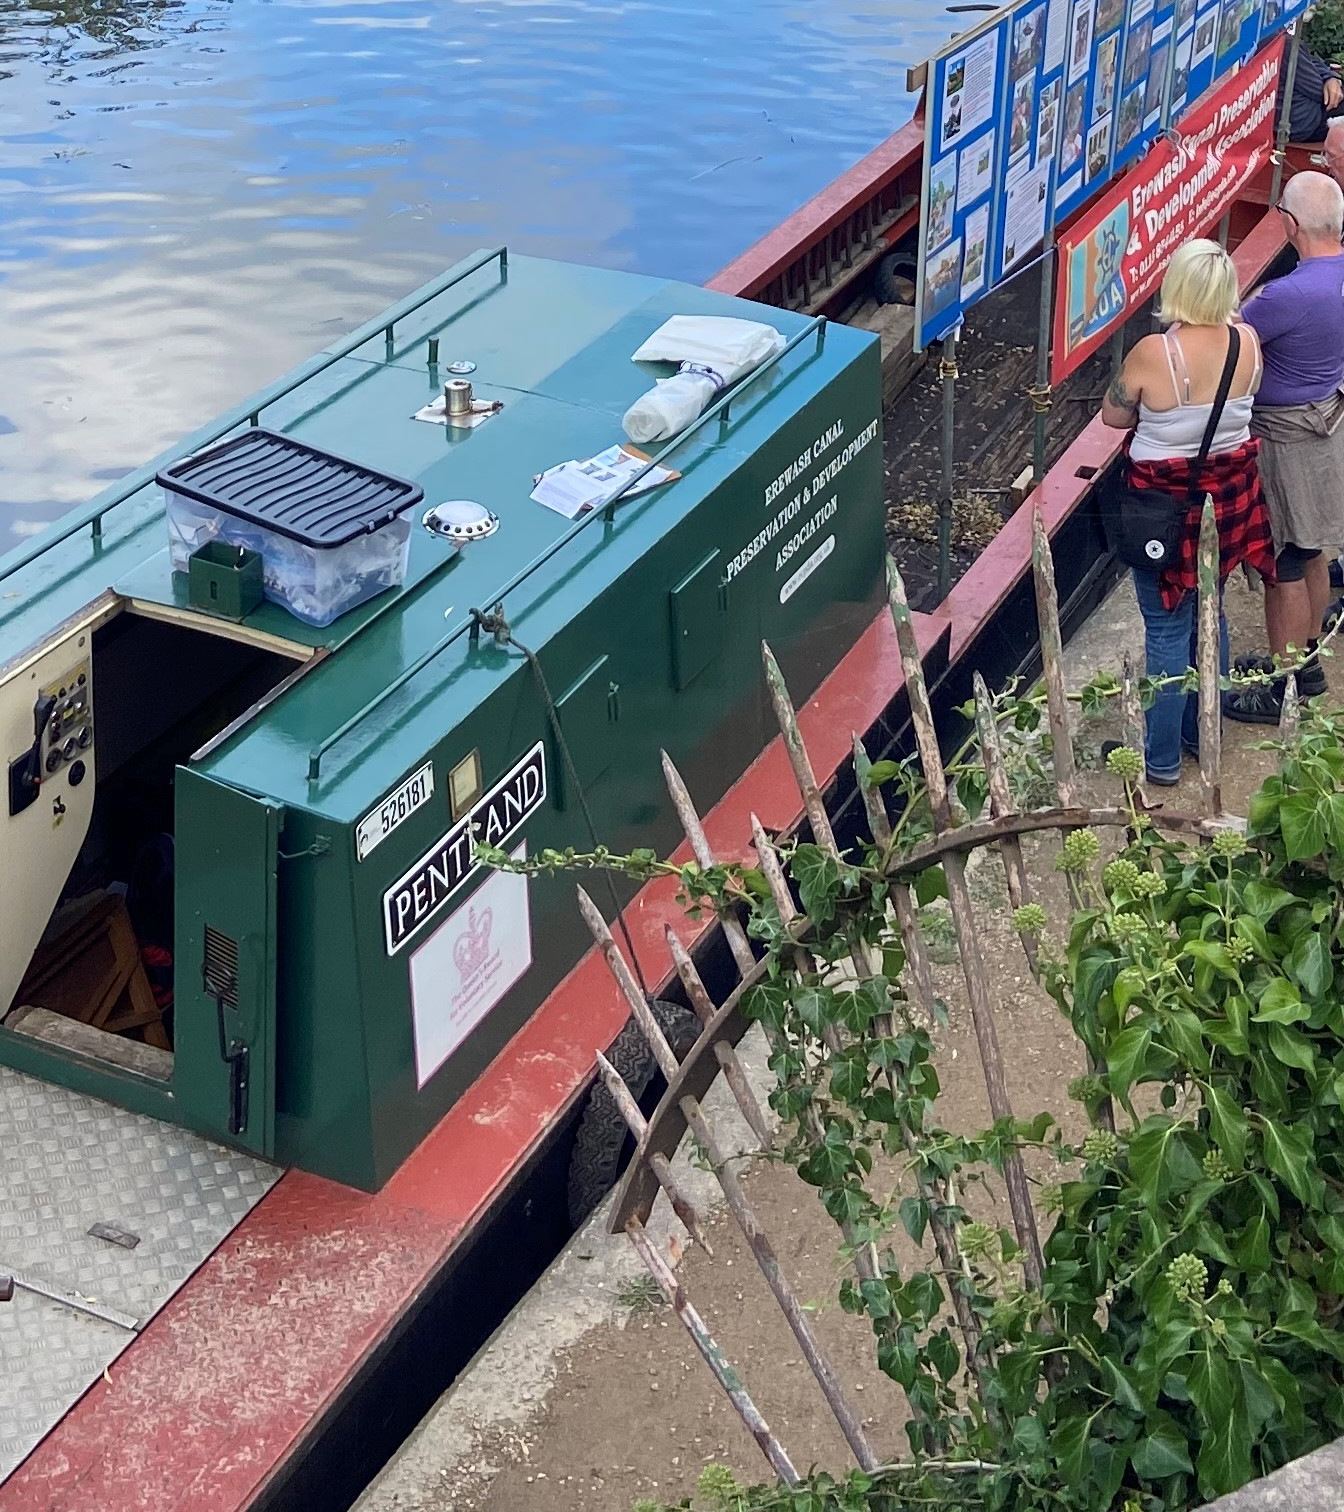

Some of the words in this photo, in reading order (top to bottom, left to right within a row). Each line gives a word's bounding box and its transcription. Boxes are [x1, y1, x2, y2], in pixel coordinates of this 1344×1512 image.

[1132, 146, 1186, 219] Erewash
[1127, 224, 1142, 255] &
[765, 447, 812, 506] EREWASH
[813, 419, 844, 458] CANAL
[727, 493, 801, 582] PRESERVATION
[803, 486, 811, 504] &
[813, 419, 879, 496] DEVELOPMENT
[776, 495, 838, 571] ASSOCIATION
[381, 774, 426, 834] 526181
